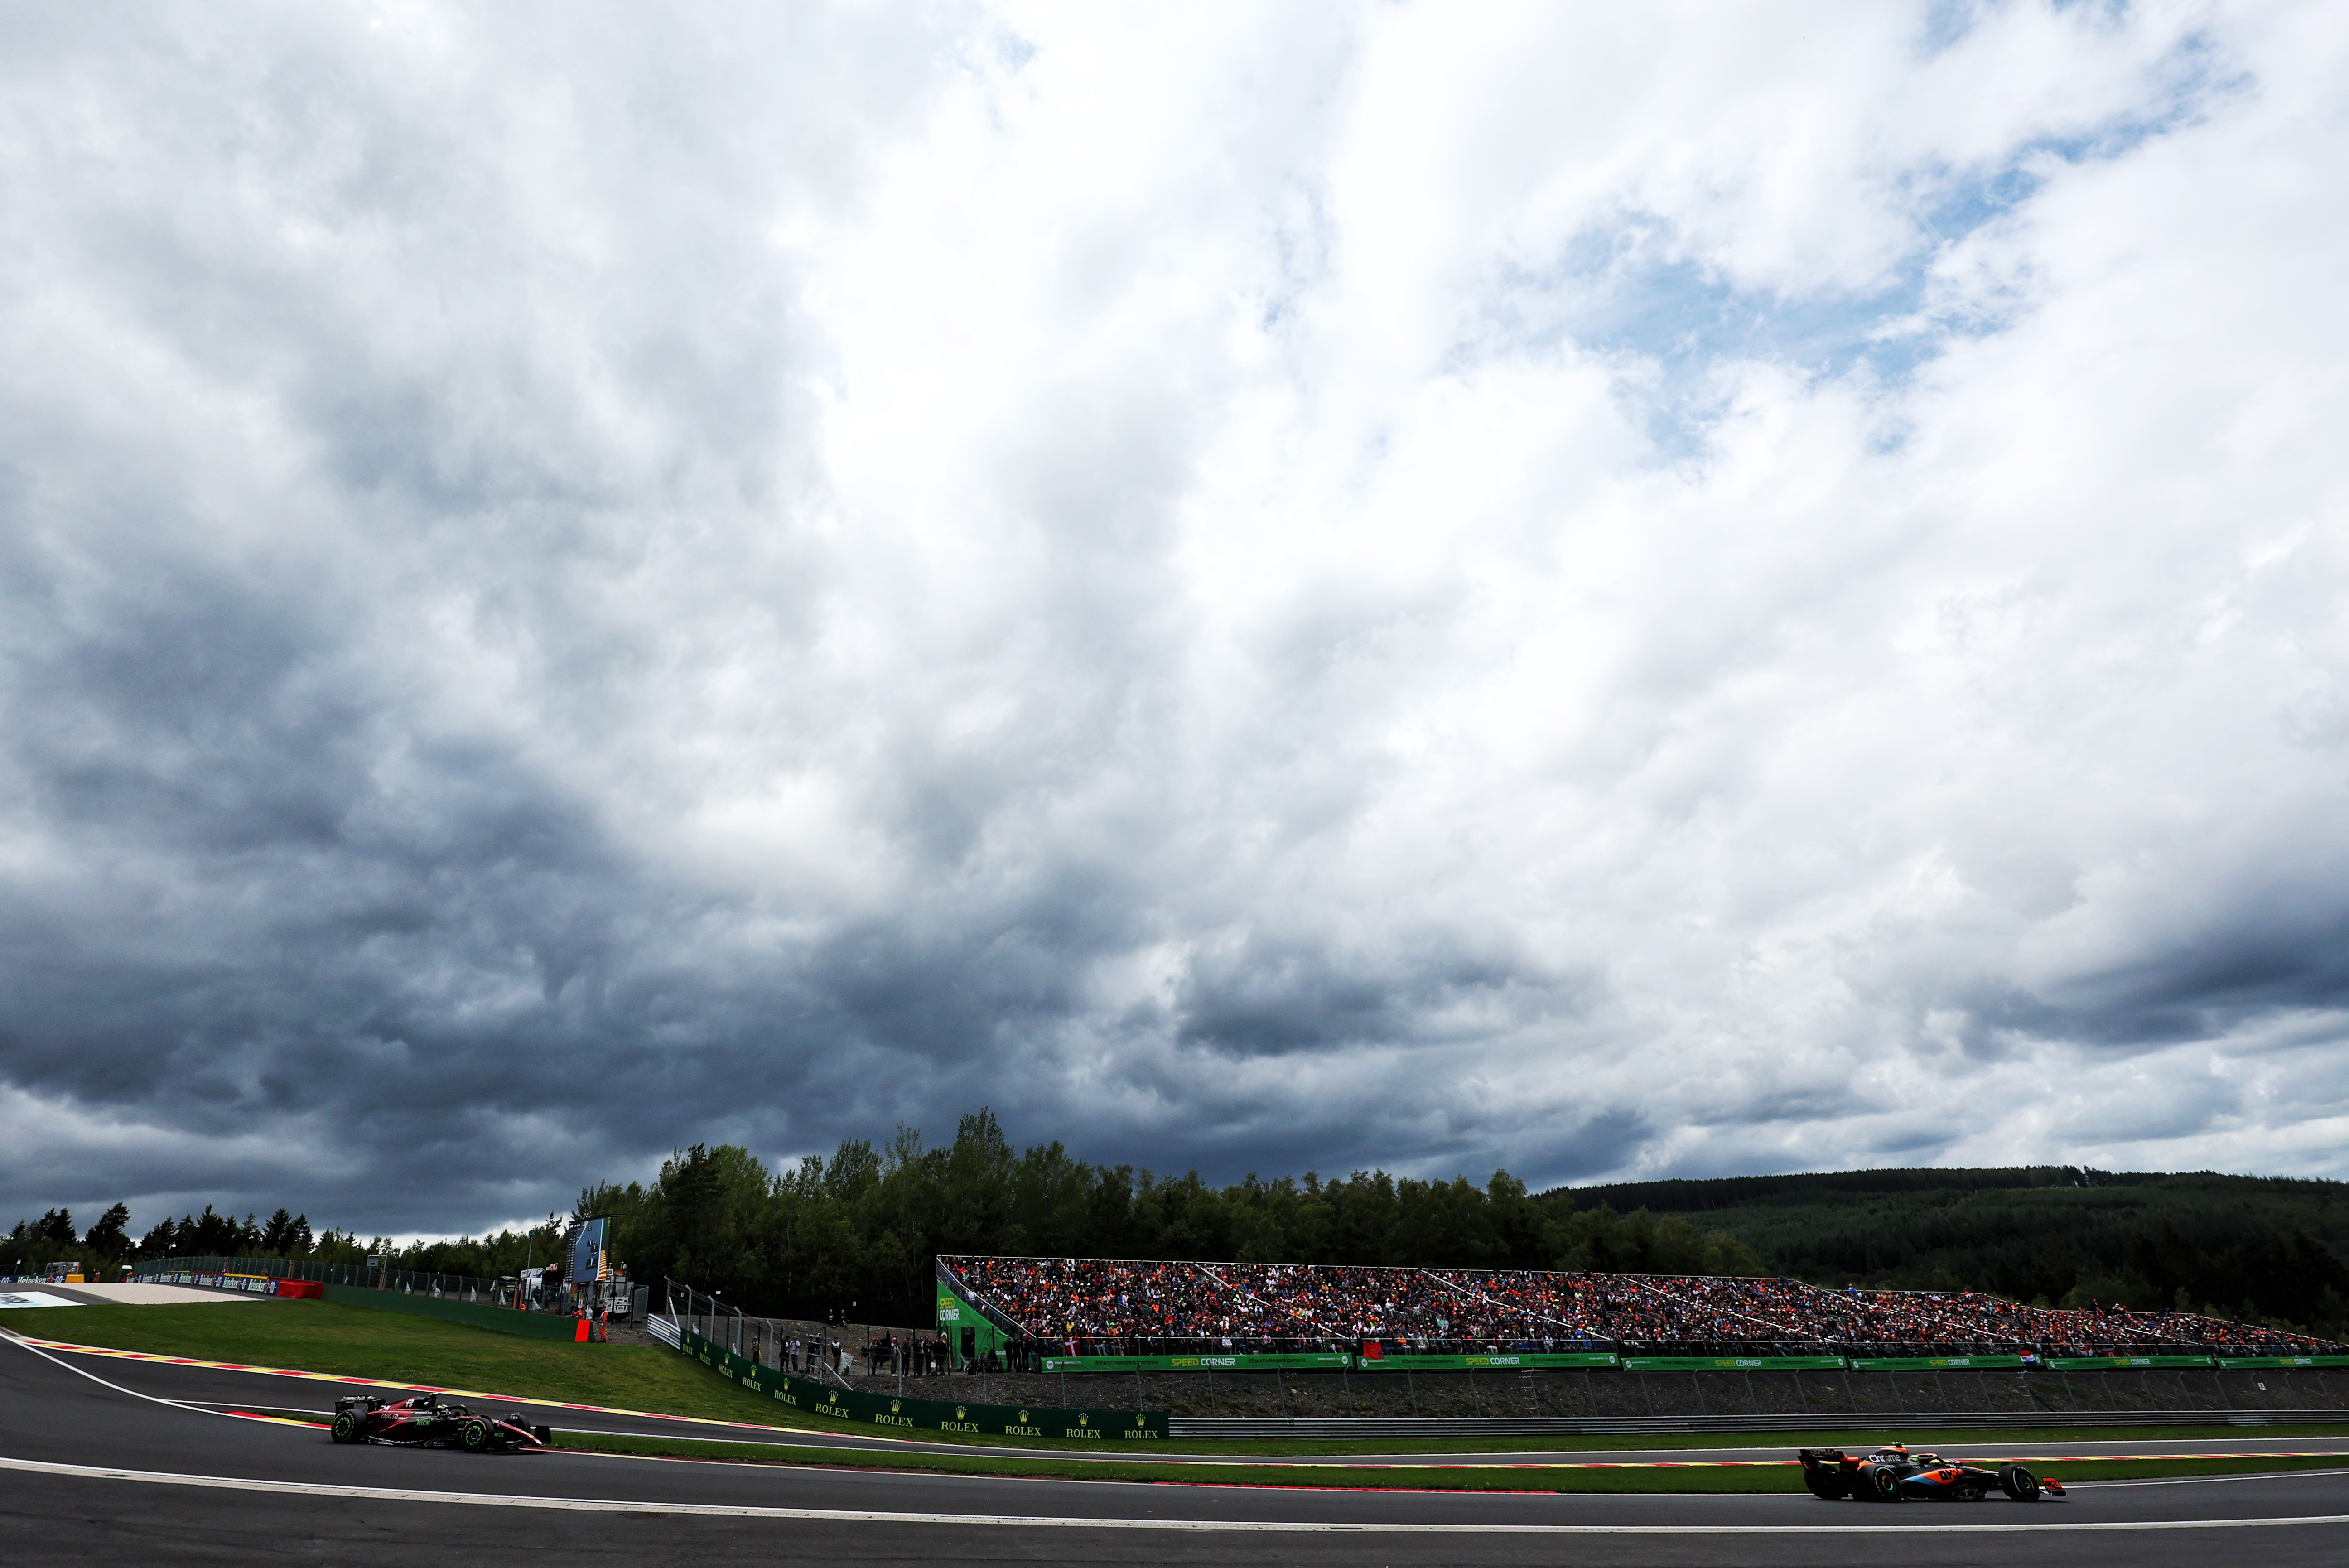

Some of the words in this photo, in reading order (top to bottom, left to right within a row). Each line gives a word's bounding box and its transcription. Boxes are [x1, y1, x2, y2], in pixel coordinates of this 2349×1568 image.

[247, 1279, 265, 1292] Heineken
[940, 1298, 955, 1309] SPEED
[940, 1308, 959, 1321] CORNER
[699, 1352, 711, 1366] ROLEX
[1172, 1358, 1199, 1366] SPEED
[1201, 1358, 1235, 1366] CORNER
[719, 1364, 733, 1379] ROLEX
[743, 1377, 761, 1392] ROLEX
[774, 1389, 797, 1405] ROLEX
[815, 1403, 849, 1418] ROLEX
[875, 1414, 914, 1427] ROLEX
[941, 1421, 979, 1433] ROLEX
[1005, 1426, 1042, 1436] ROLEX
[1066, 1428, 1101, 1438] ROLEX
[1124, 1430, 1158, 1439] ROLEX
